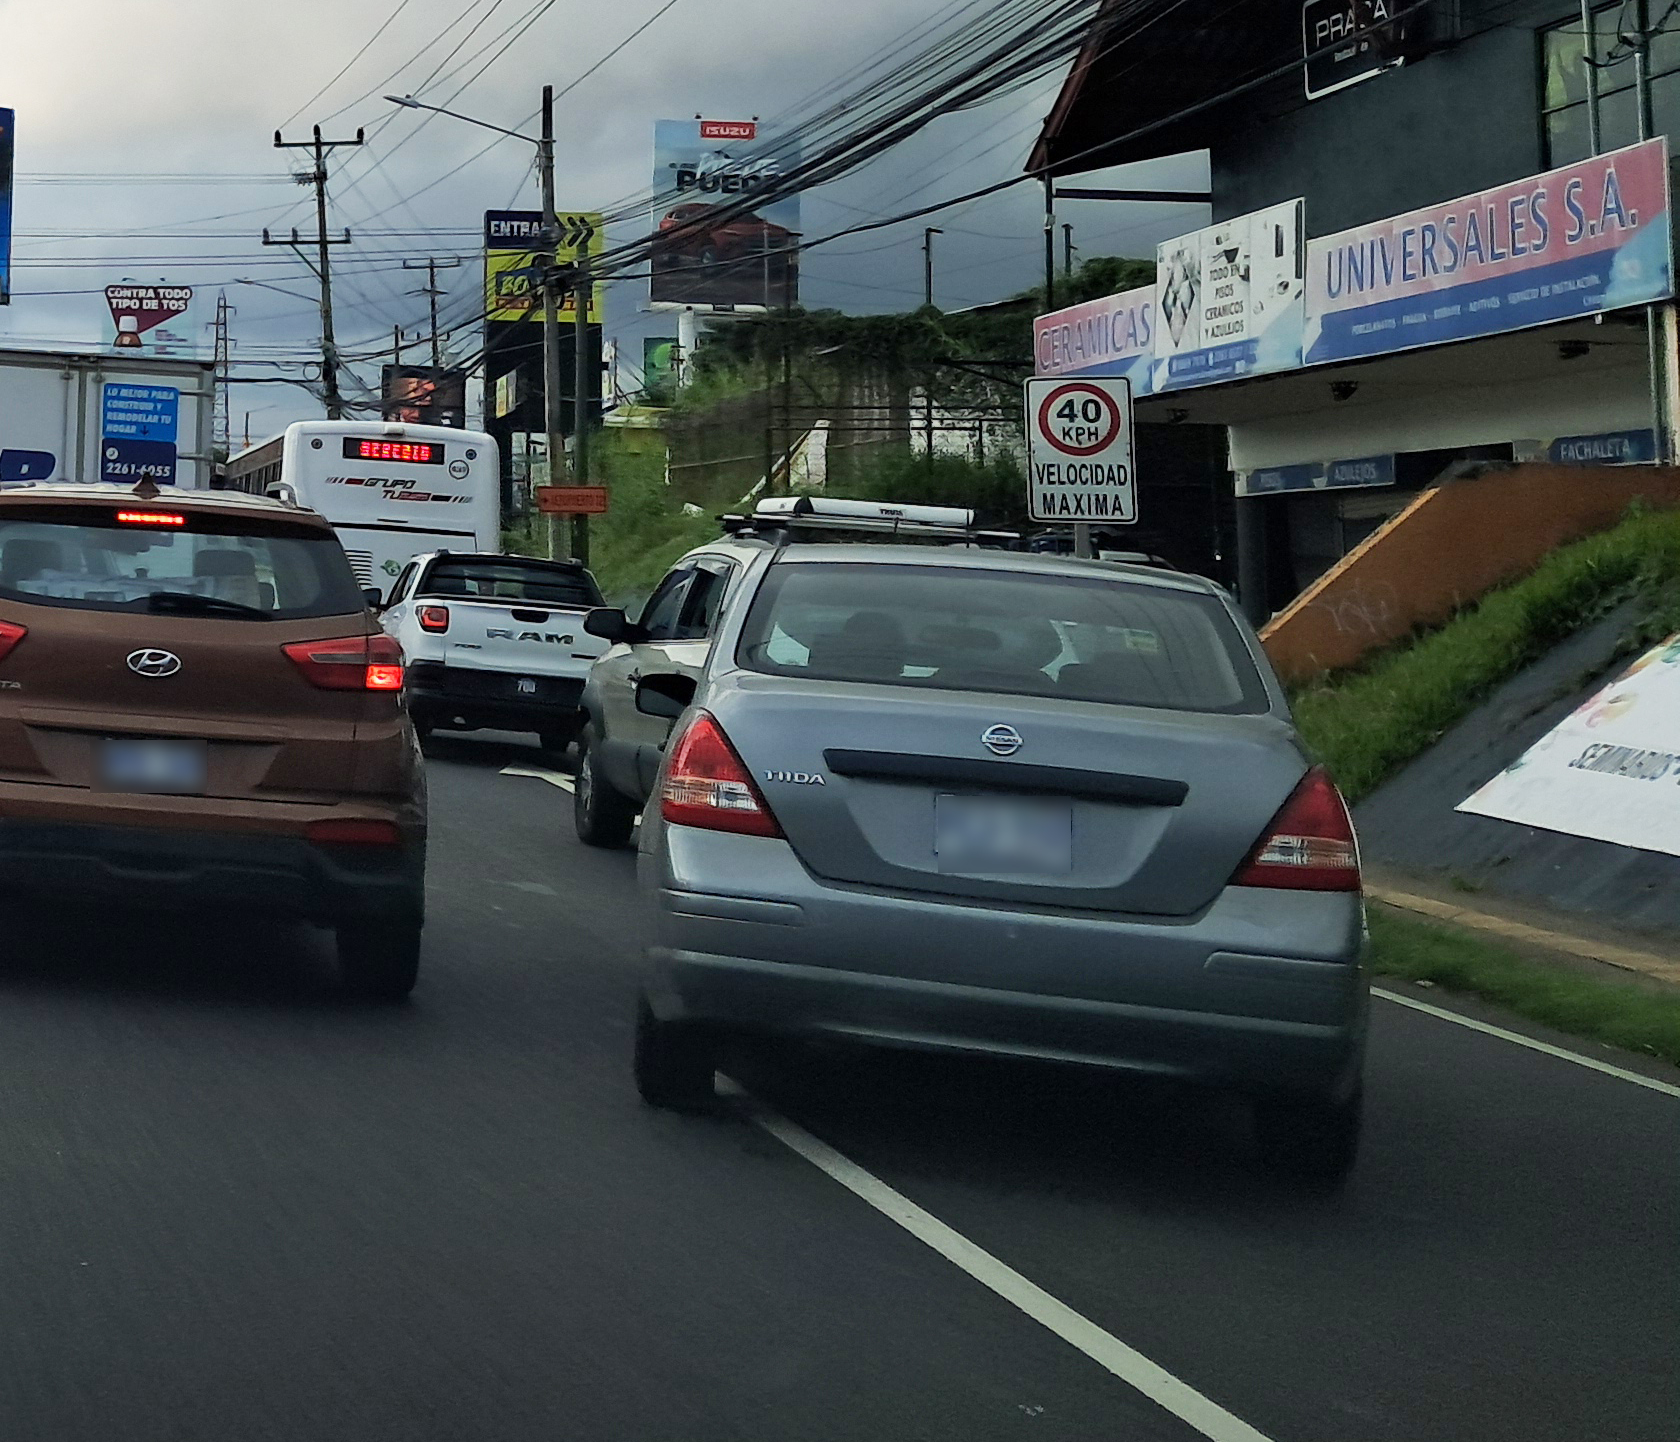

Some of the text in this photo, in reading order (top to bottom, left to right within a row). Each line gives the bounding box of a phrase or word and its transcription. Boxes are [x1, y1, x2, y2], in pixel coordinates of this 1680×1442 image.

[705, 126, 750, 136] ISUZU
[1326, 168, 1638, 300] UNIVERSALES S.A.
[1210, 265, 1228, 281] TODO
[107, 288, 191, 299] CONTRA TODO
[111, 298, 186, 310] TIPO DE TOS
[1038, 303, 1151, 370] CERAMICAS
[1057, 398, 1102, 424] 40
[1062, 426, 1099, 442] KPH
[1560, 438, 1632, 460] FACHALETA
[106, 462, 171, 477] 2261-6055
[1036, 463, 1127, 487] VELOCIDAD
[1042, 492, 1124, 516] MAXIMA
[486, 628, 573, 645] RAM
[764, 769, 826, 787] TIIDA
